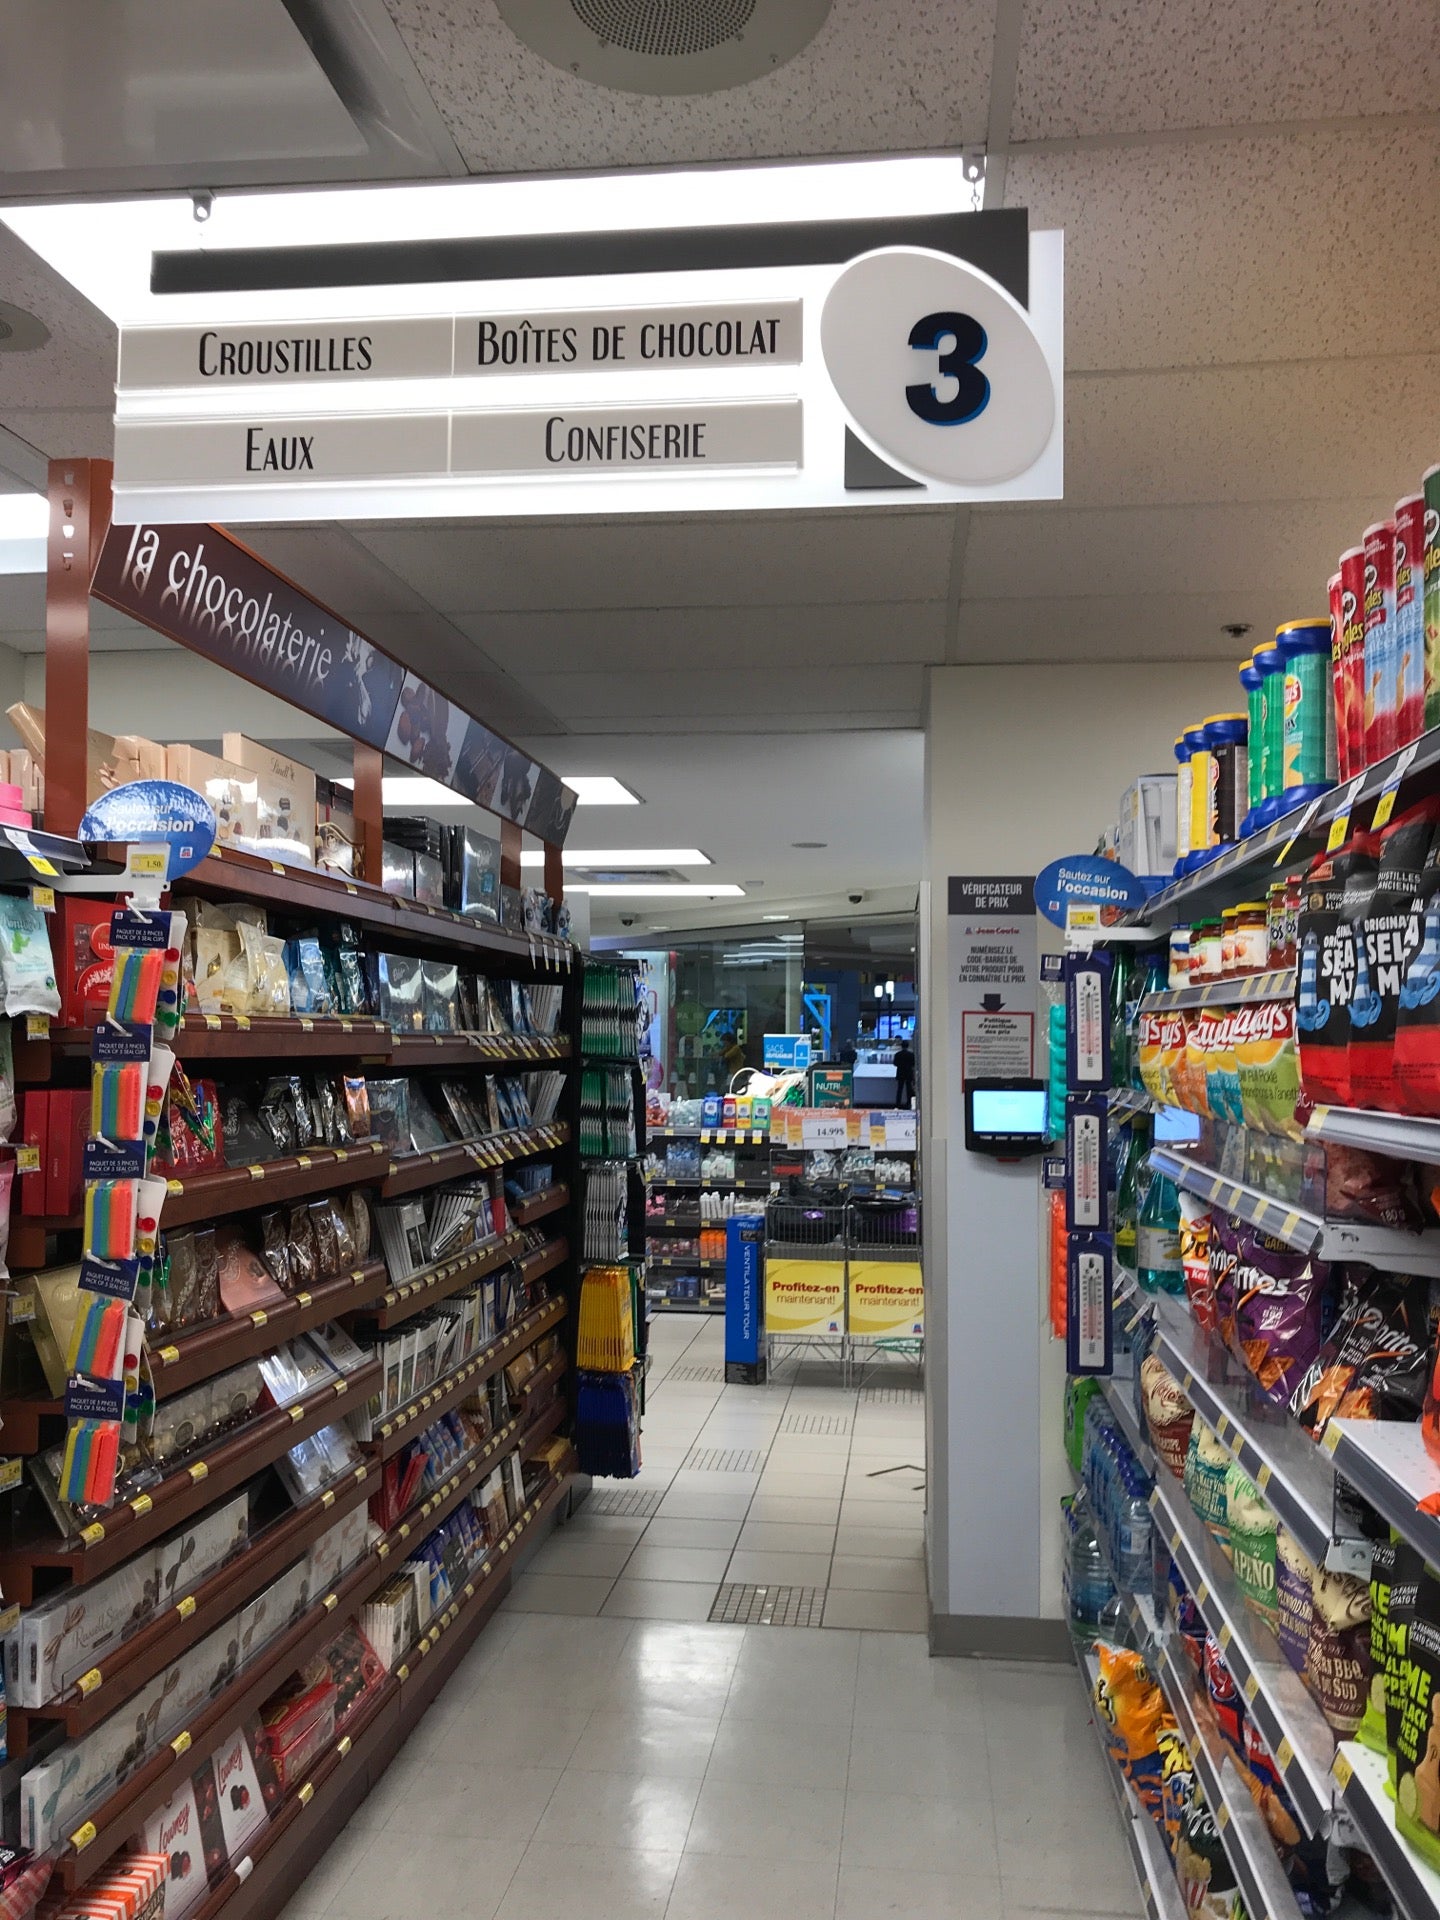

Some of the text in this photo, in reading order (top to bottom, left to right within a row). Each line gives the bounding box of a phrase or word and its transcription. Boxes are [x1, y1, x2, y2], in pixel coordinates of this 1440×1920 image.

[477, 318, 781, 366] BOÎTES DE CHOCOLAT
[198, 331, 373, 377] CROUSTILLES
[905, 311, 991, 427] 3
[544, 416, 707, 463] CONFISERIE
[245, 427, 315, 471] EAUX
[166, 543, 333, 680] chocolaterie
[1058, 868, 1111, 884] Sautez sur
[962, 882, 1022, 896] VÉRIFICATEUR
[1057, 879, 1129, 901] l'occasion
[1377, 881, 1417, 893] ANCIENN
[975, 897, 1009, 908] DE PRIX
[975, 927, 995, 935] Jean
[970, 944, 1014, 955] NUMÉRISEZ LE
[1009, 955, 1018, 964] DE
[961, 964, 1024, 973] VOTRE PRODUIT POUR
[959, 974, 968, 983] EN
[1002, 974, 1010, 983] LE
[1011, 974, 1026, 983] PRIX
[772, 1281, 840, 1293] Profitez-en
[1234, 1265, 1291, 1296] ritos
[743, 1244, 751, 1340] VENTILATEUR TOUR
[855, 1283, 924, 1295] Profitez-en
[776, 1293, 836, 1305] maintenant!
[859, 1295, 920, 1307] maintenant!
[1234, 1548, 1275, 1591] APEÑO
[217, 1743, 244, 1798] Lowney
